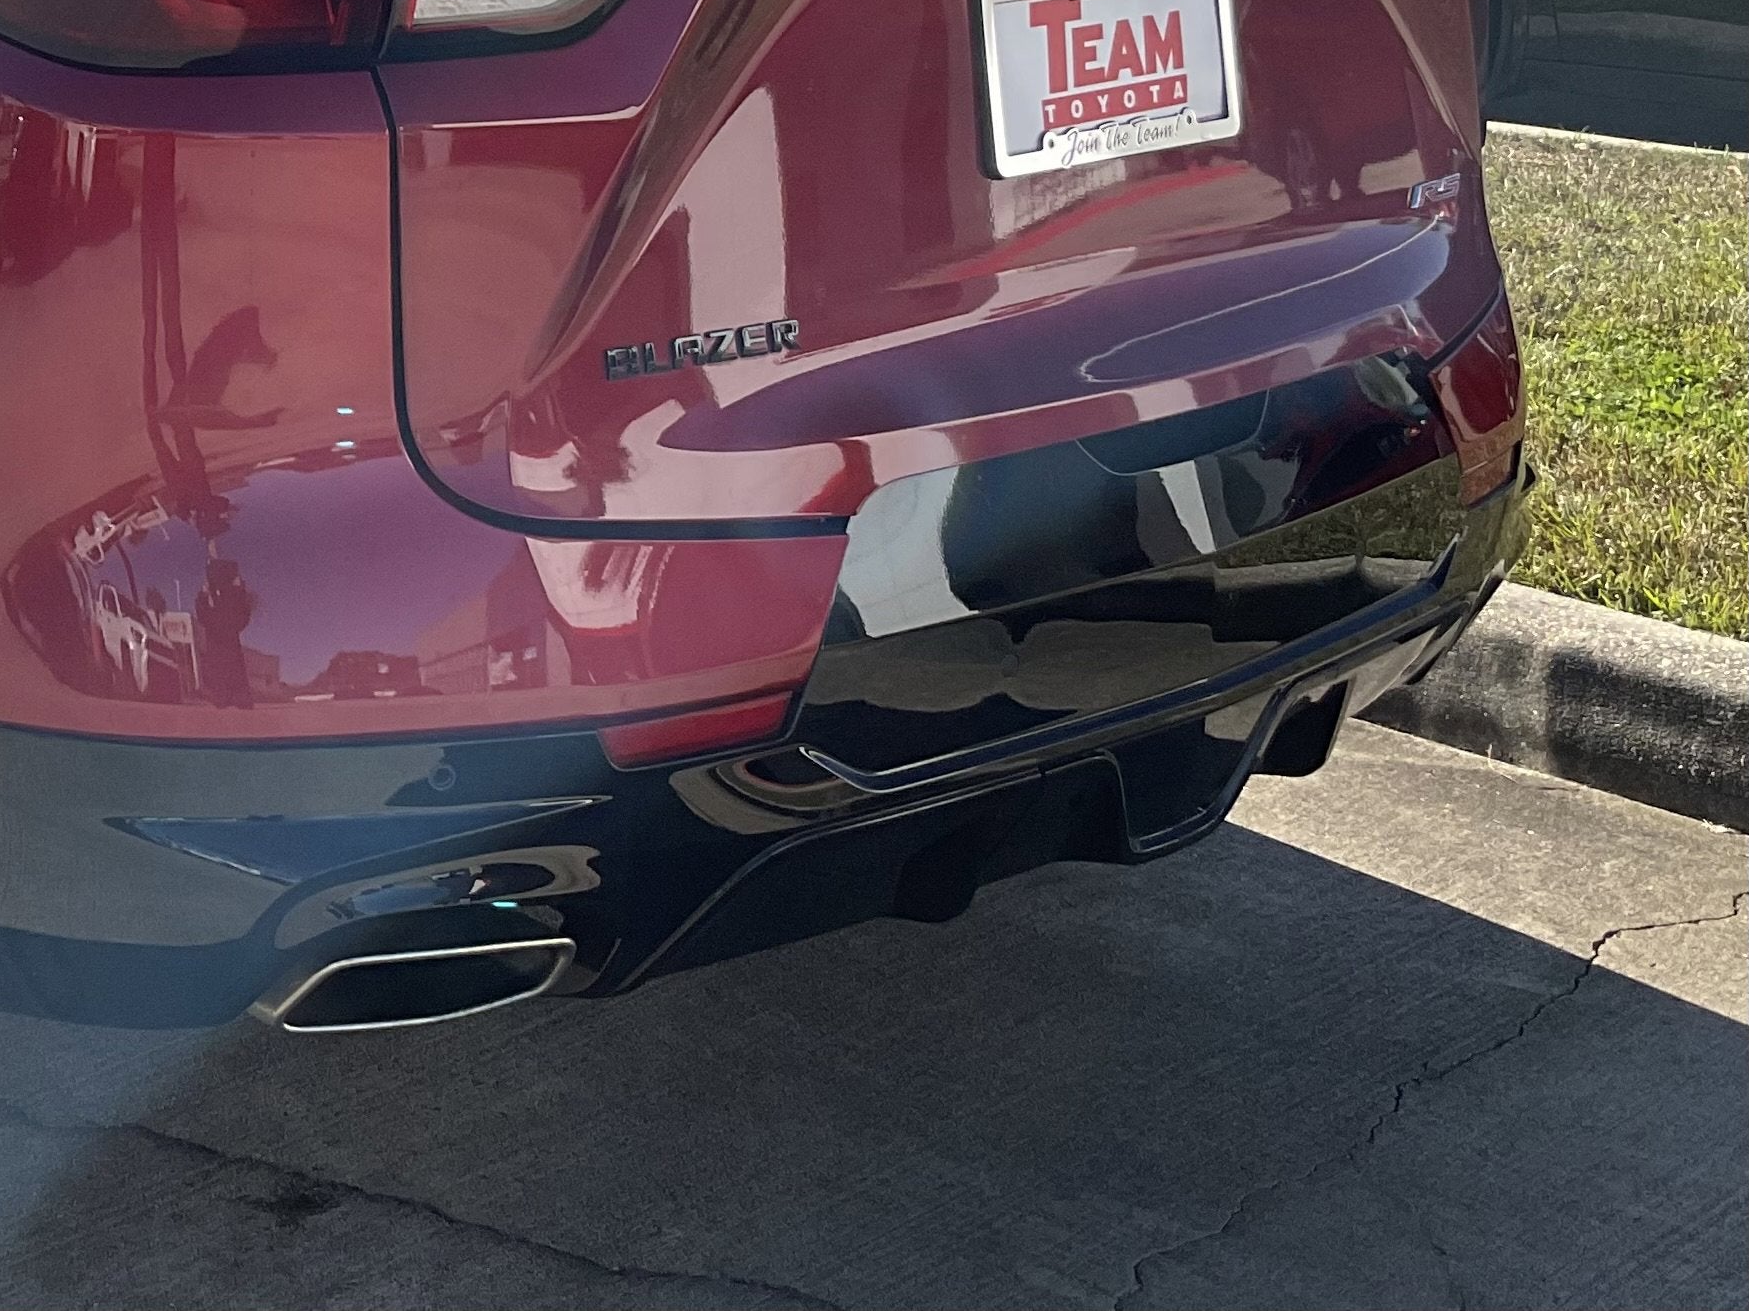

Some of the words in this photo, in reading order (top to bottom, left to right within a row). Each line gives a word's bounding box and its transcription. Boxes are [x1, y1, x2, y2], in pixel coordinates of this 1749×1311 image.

[1044, 80, 1185, 124] TOYOTA
[1061, 130, 1098, 166] Join
[1101, 121, 1130, 151] The
[1131, 115, 1180, 146] Team!
[605, 319, 801, 381] BLAZER
